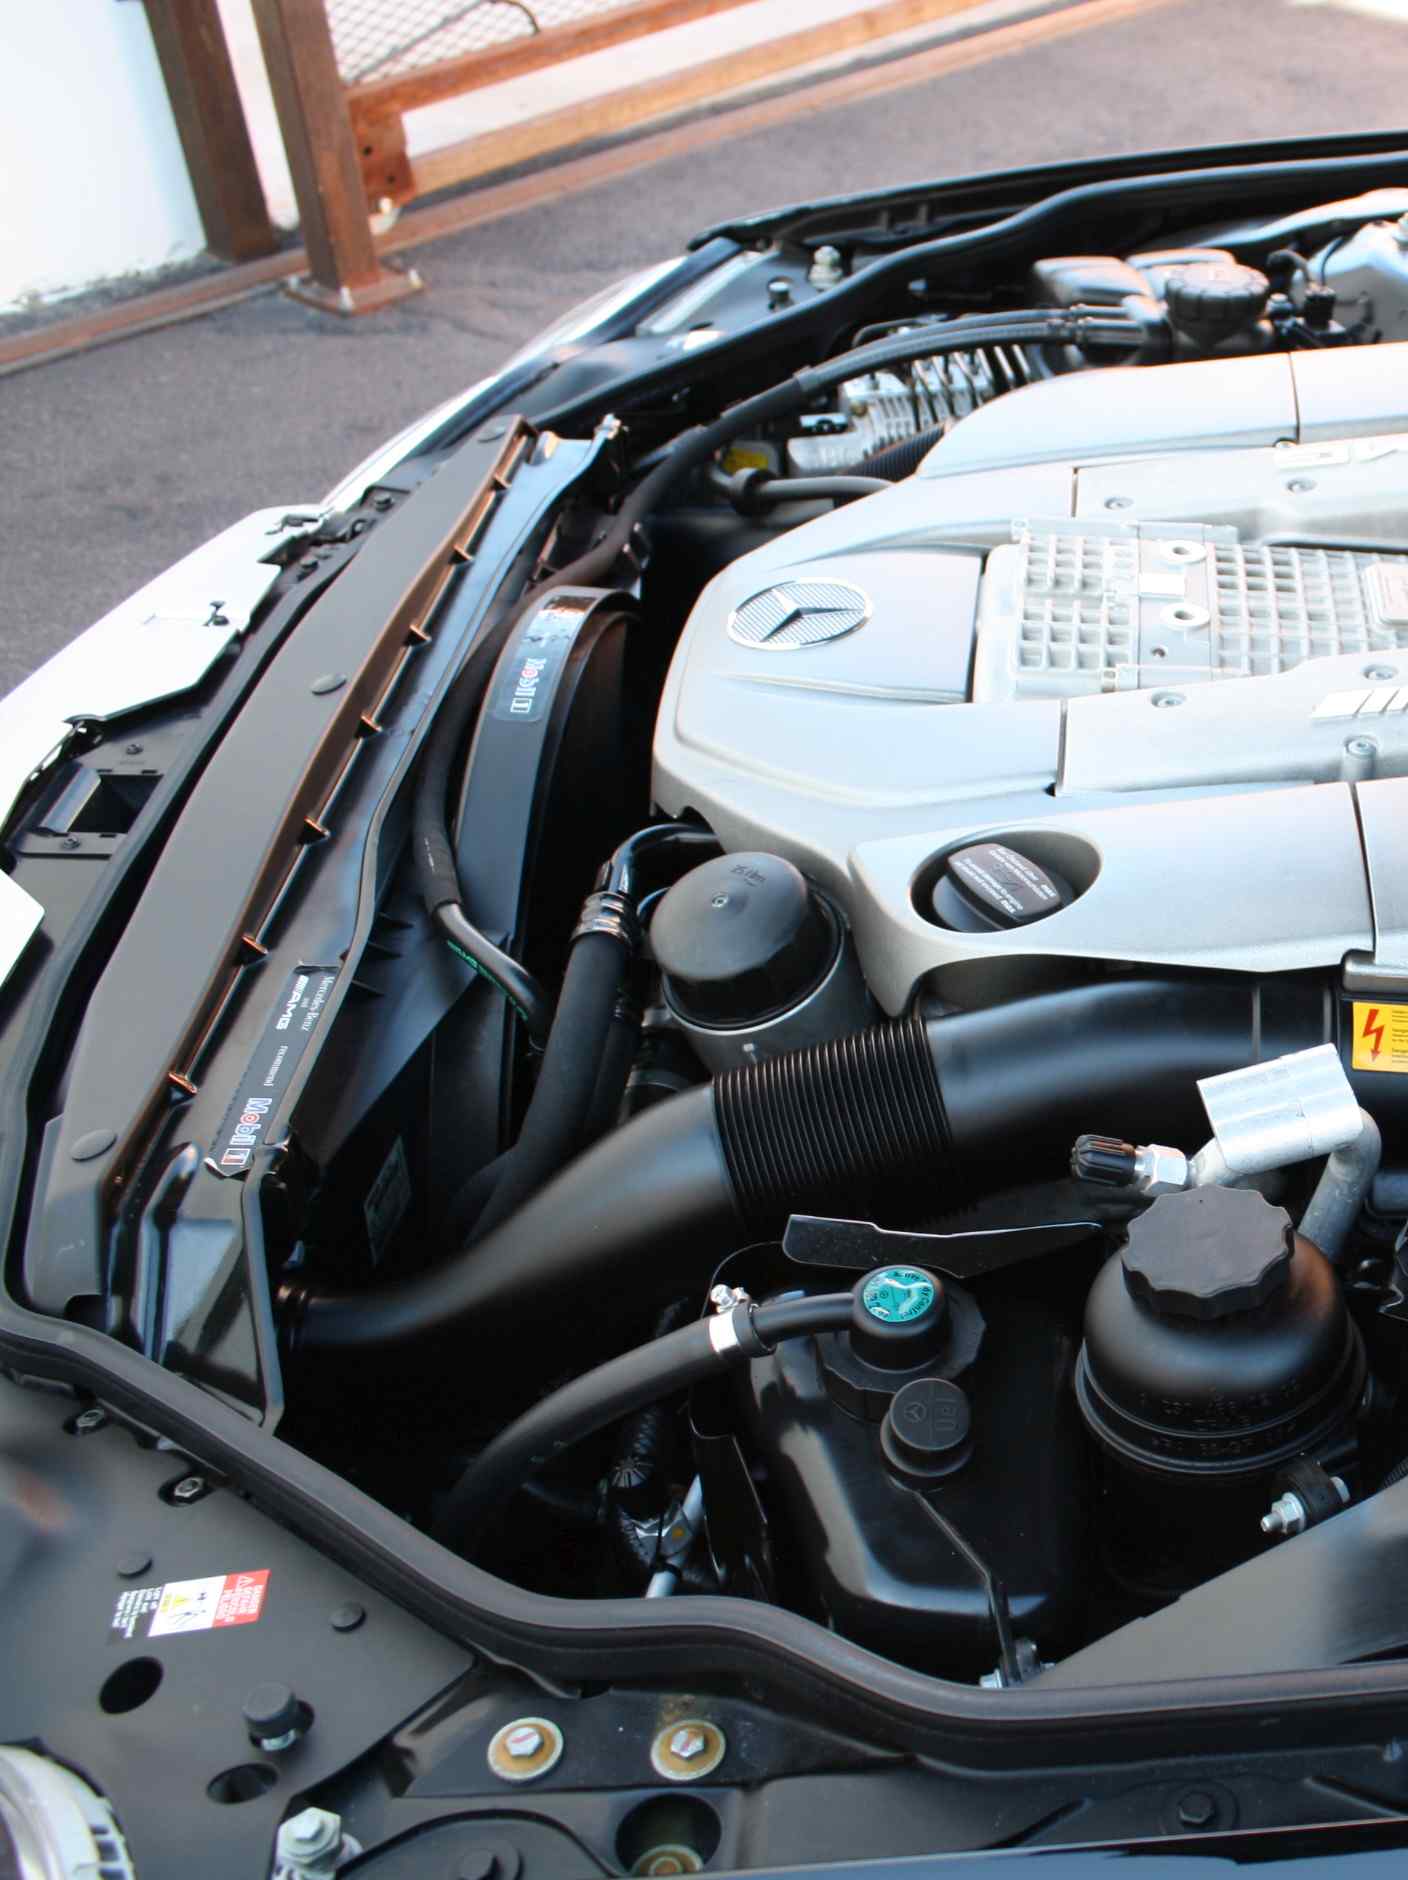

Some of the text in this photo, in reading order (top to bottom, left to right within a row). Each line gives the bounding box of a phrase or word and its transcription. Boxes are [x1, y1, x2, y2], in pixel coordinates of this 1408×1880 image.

[513, 657, 547, 697] Mobil
[220, 1097, 273, 1167] Mobil 1
